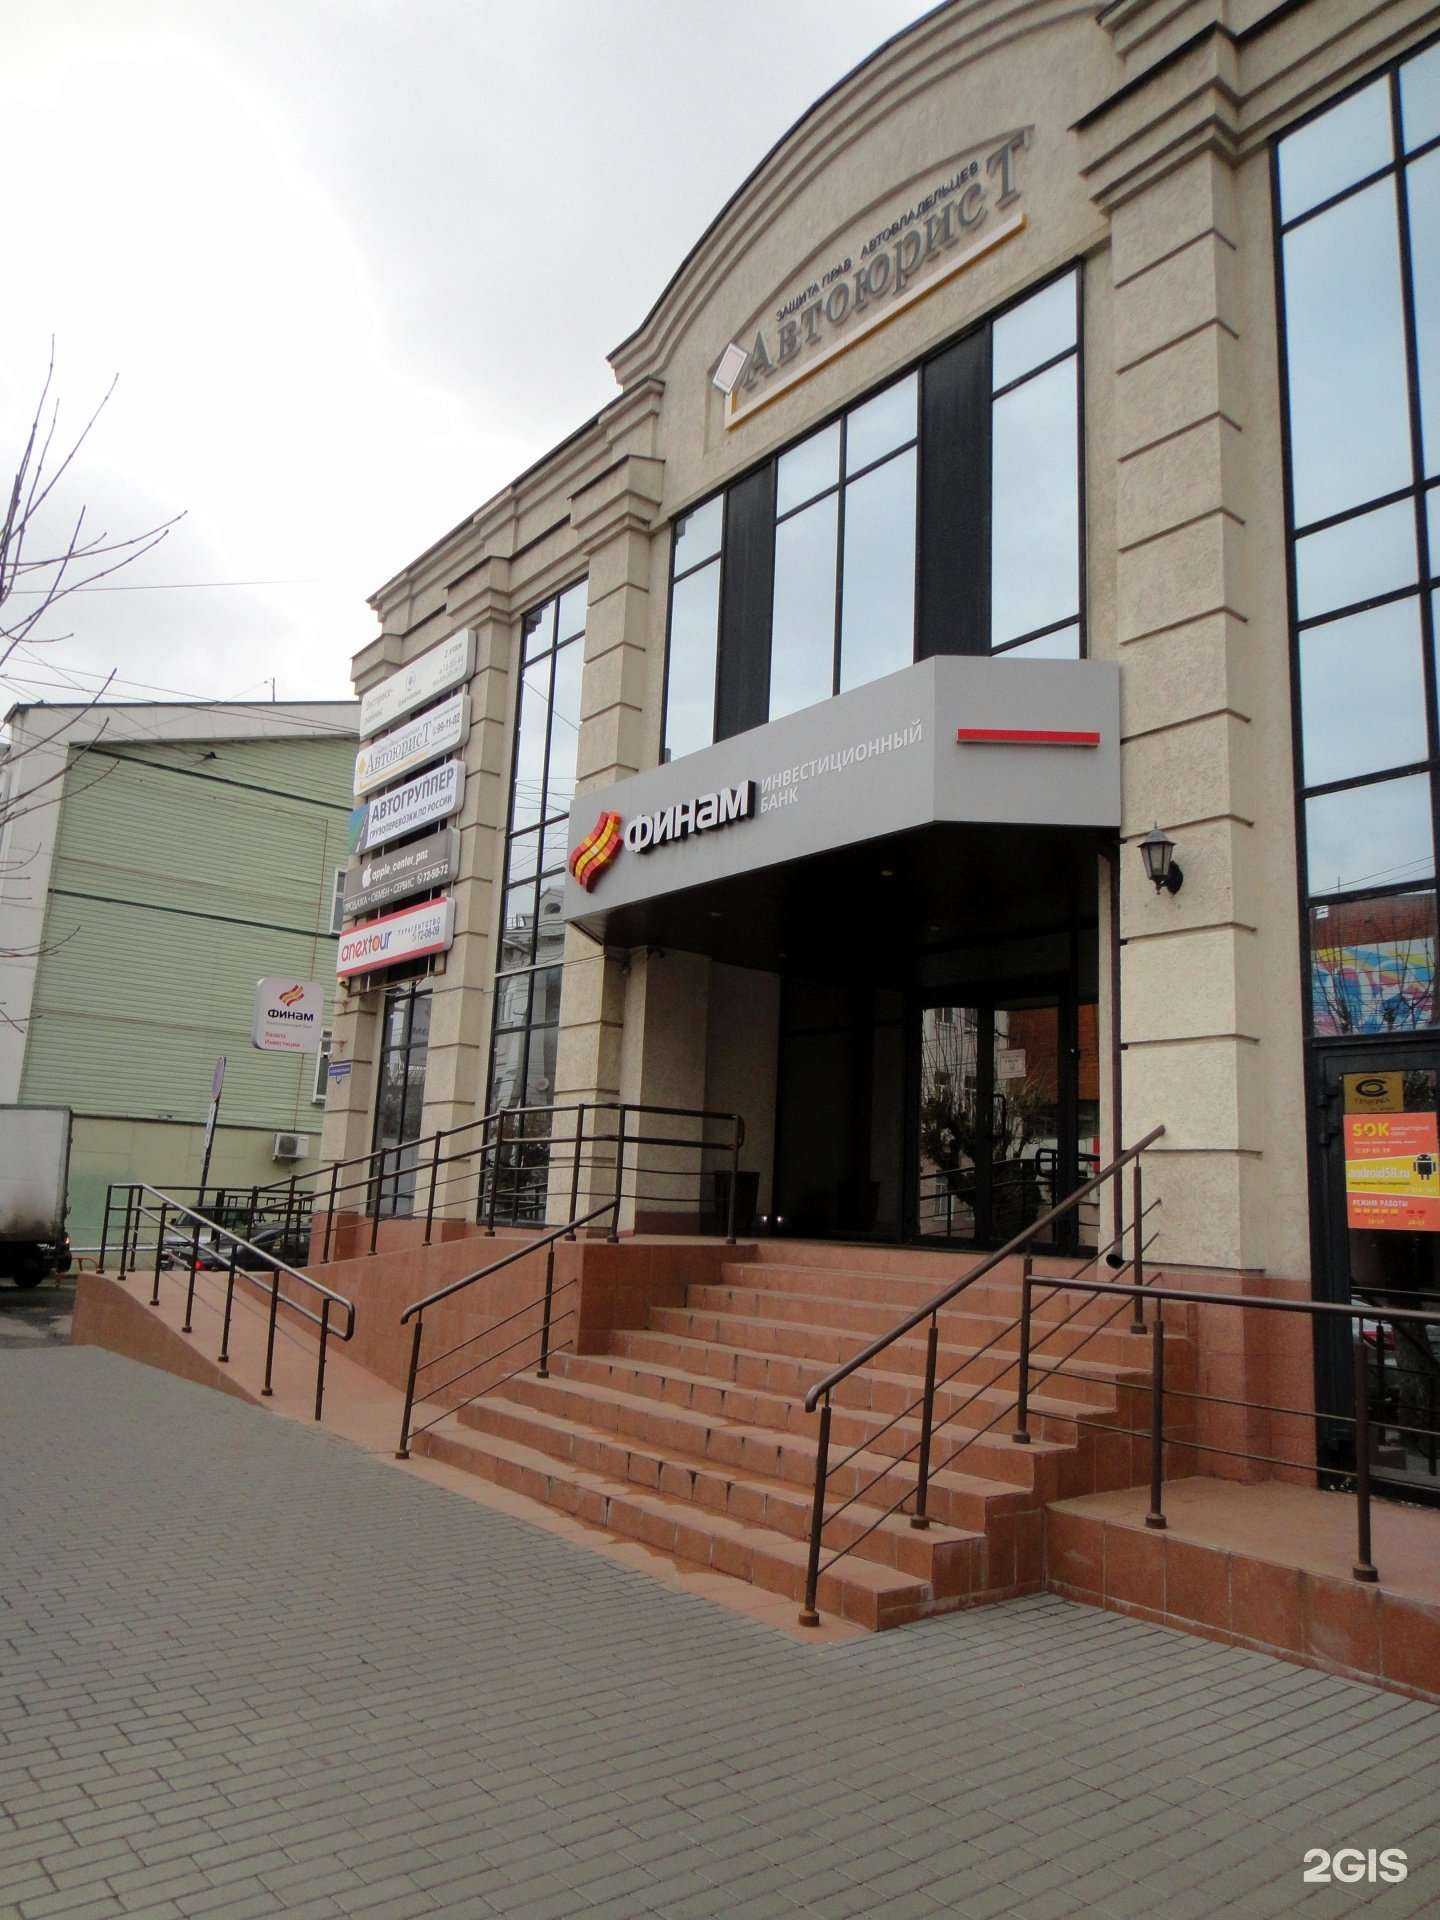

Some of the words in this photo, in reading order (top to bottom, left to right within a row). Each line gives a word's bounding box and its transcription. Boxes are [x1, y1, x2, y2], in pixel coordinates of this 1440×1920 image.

[776, 281, 820, 321] ЗАЩИТА
[821, 257, 852, 287] ПРАВ
[860, 160, 979, 258] АВТОВЛАДЕЛЬЦЕВ
[760, 719, 923, 794] ИНВЕСТИЦИОННЫЙ
[371, 768, 454, 822] АВТОГРУППЕР
[760, 786, 799, 813] БАНК
